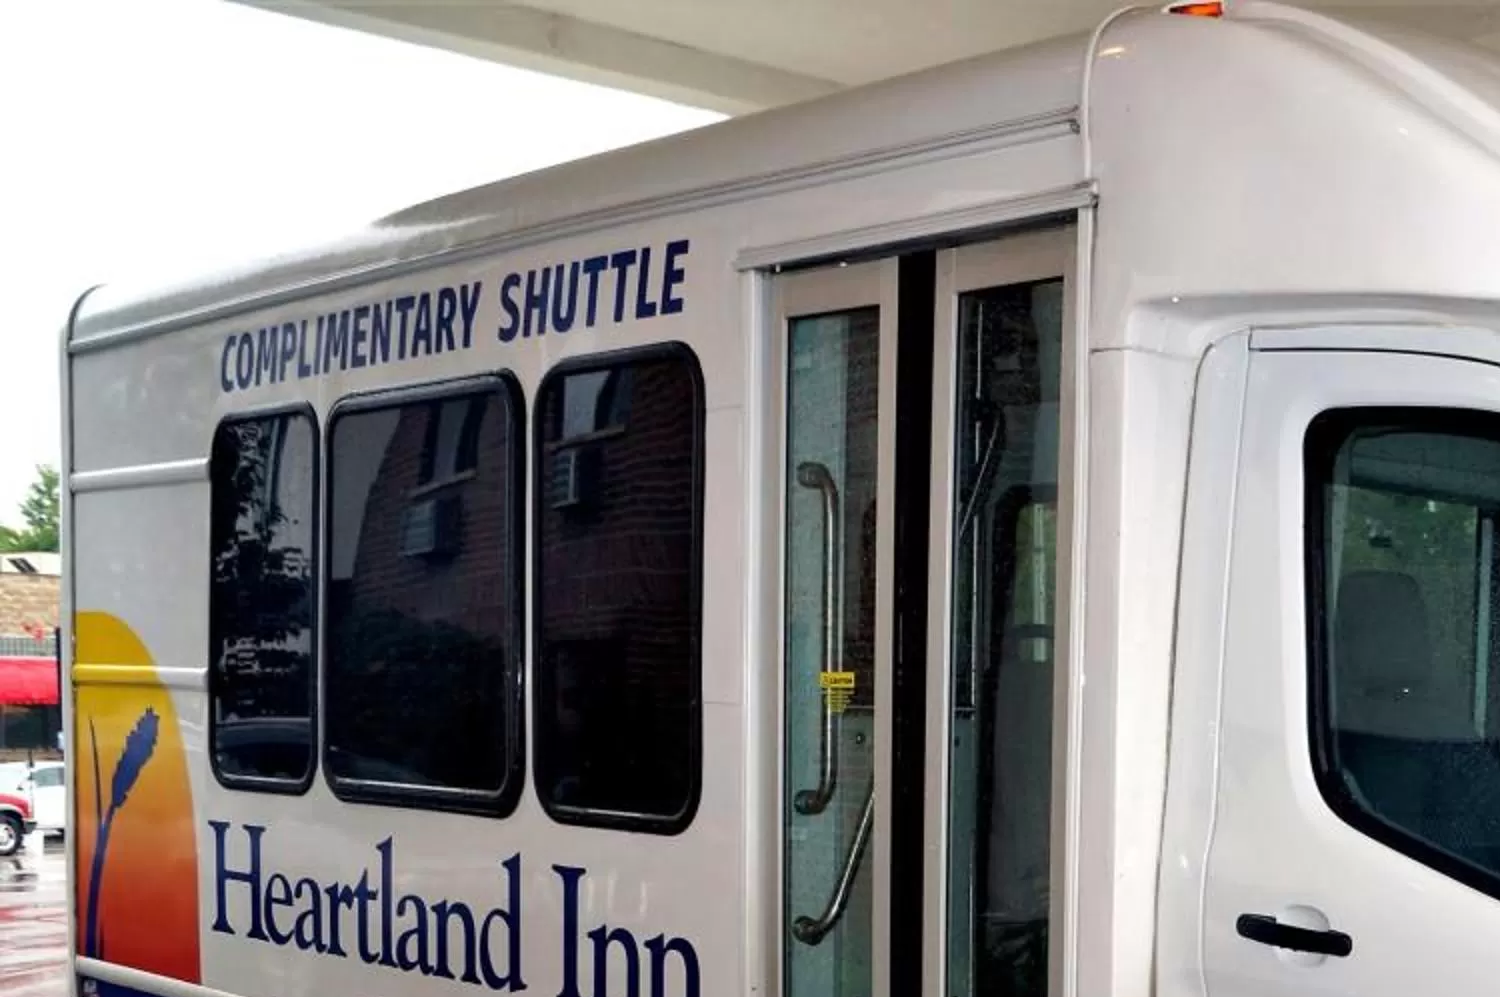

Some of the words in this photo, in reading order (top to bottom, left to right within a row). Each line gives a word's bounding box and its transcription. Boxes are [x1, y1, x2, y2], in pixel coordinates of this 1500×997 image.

[220, 281, 482, 392] COMPLIMENTARY
[498, 239, 689, 342] SHUTTLE
[207, 820, 527, 992] Heartland
